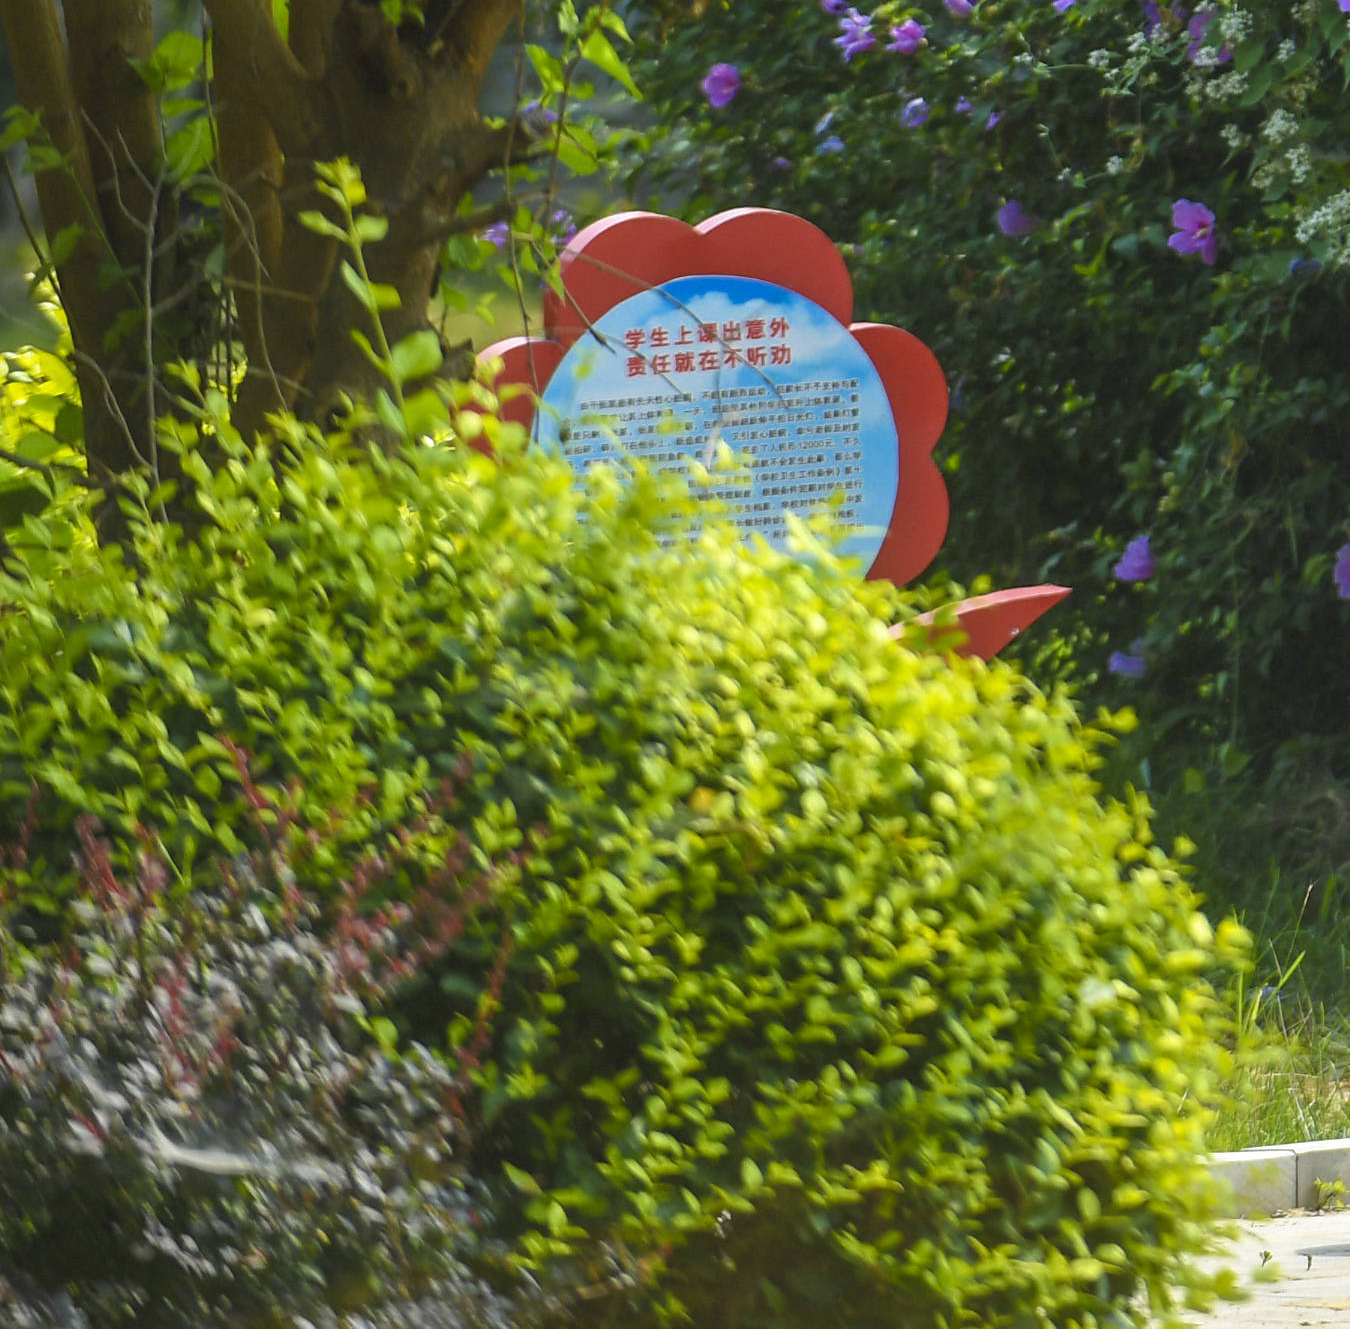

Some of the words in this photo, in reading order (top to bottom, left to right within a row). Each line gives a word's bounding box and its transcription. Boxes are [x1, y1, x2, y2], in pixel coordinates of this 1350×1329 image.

[624, 317, 790, 349] 学生上课出意外
[625, 344, 792, 377] 责任就在不听劝
